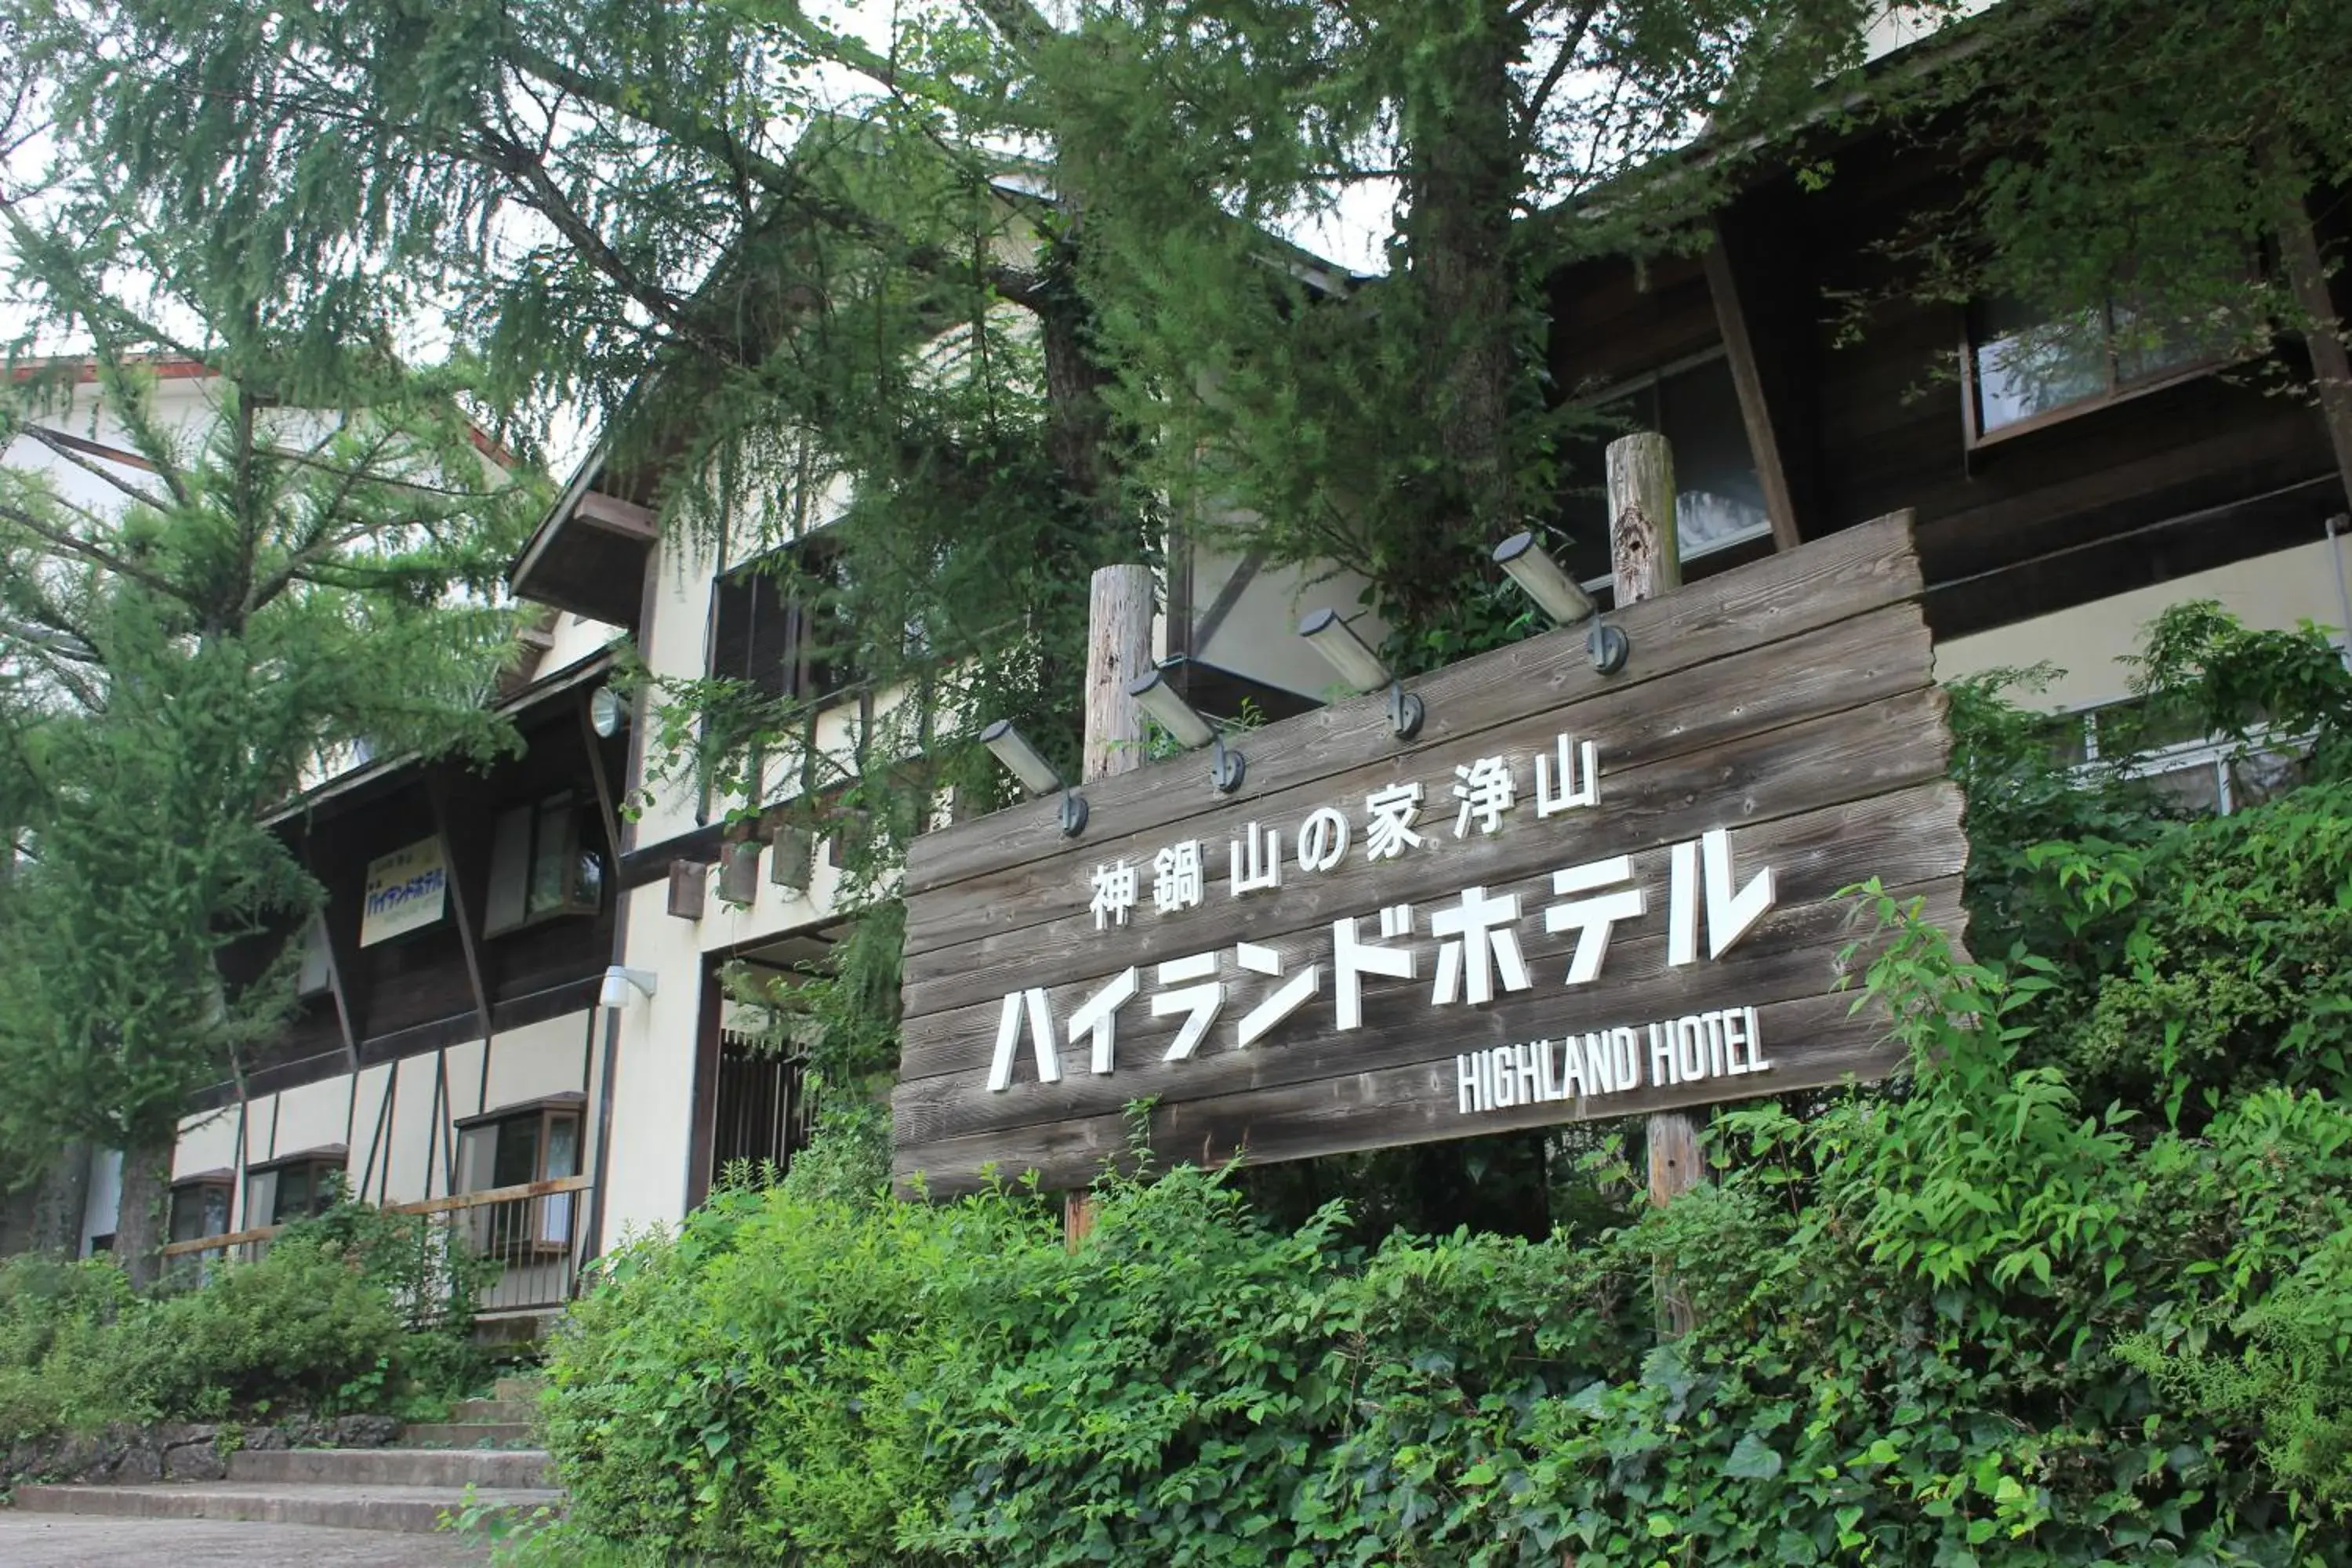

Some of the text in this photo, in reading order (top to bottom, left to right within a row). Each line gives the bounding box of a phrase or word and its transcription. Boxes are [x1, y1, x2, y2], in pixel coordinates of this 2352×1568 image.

[986, 828, 1777, 1091] ハイランドホテル
[1457, 1006, 1772, 1114] HIGHLAND HOTEL
